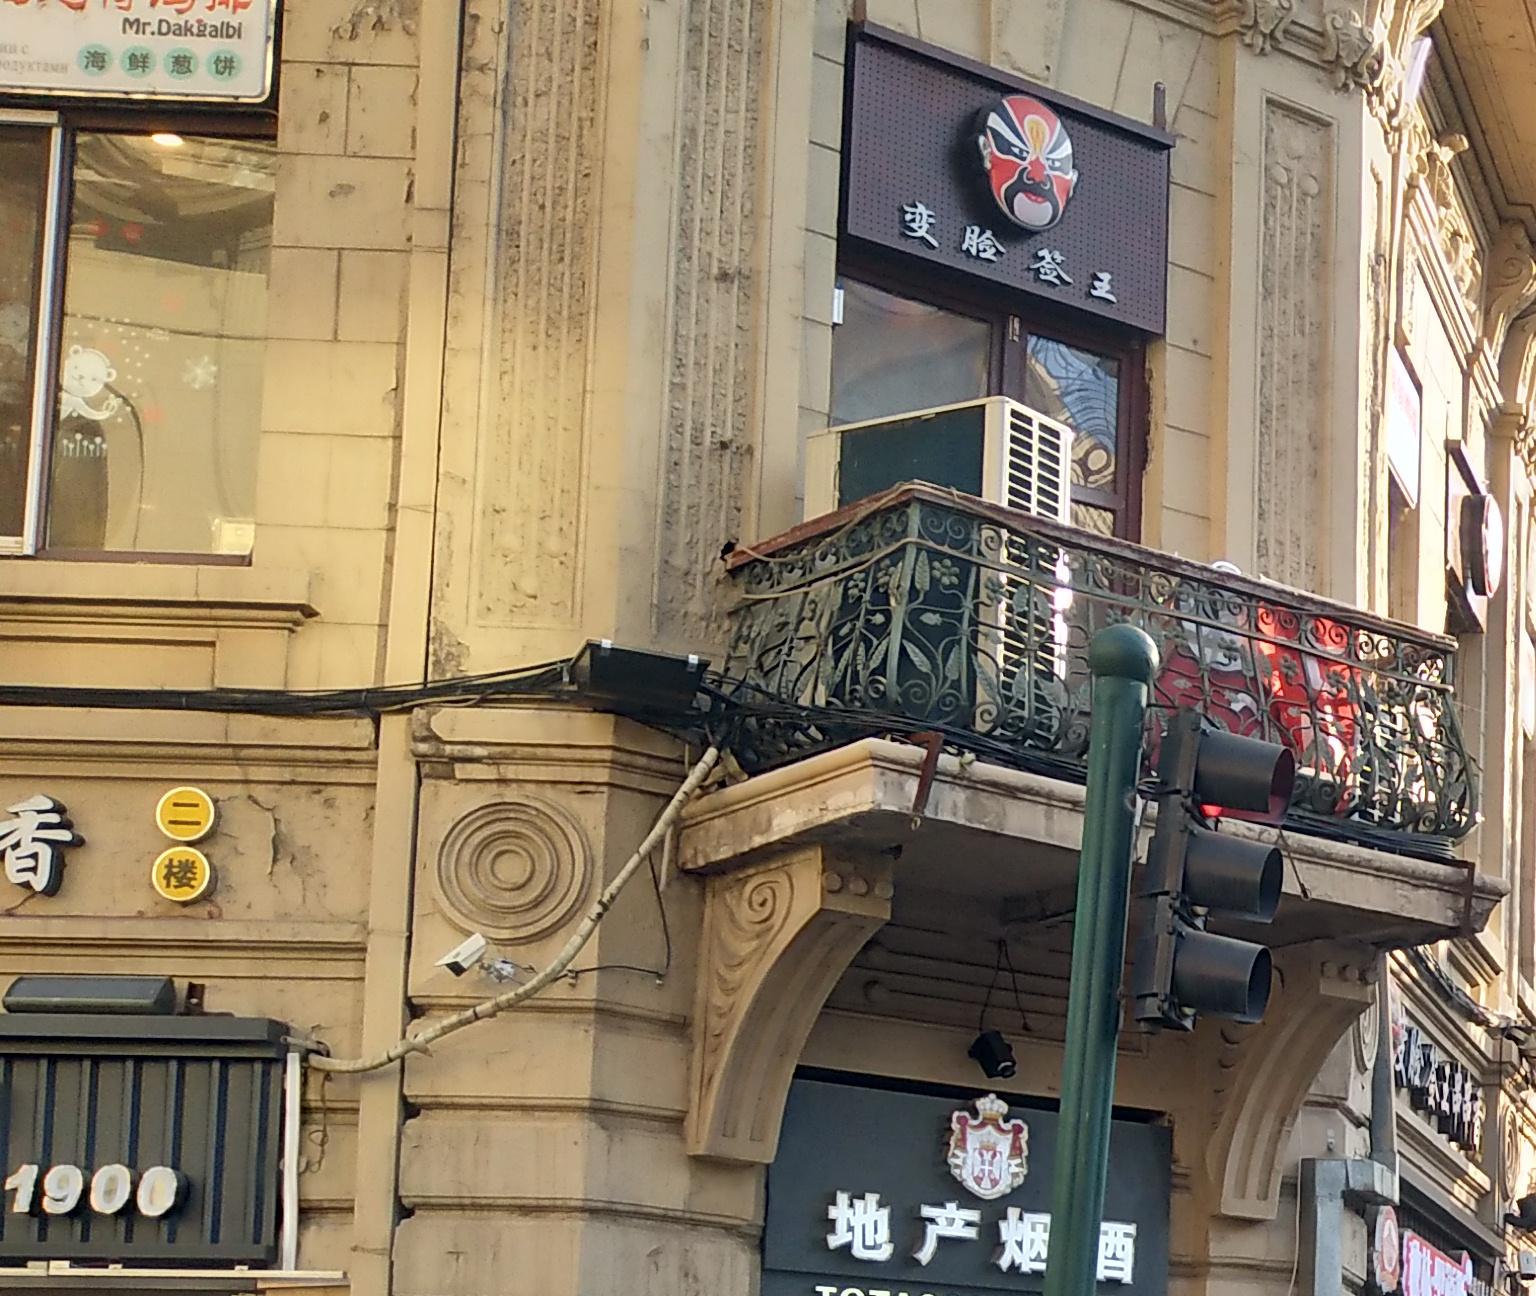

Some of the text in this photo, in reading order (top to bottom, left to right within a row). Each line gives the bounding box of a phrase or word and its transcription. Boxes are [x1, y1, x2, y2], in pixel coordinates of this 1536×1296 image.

[121, 17, 244, 40] Mr.Dakgalbi
[83, 49, 237, 77] 海鲜葱饼
[0, 794, 72, 893] 香
[161, 801, 203, 891] 二楼
[4, 1163, 178, 1218] 1900
